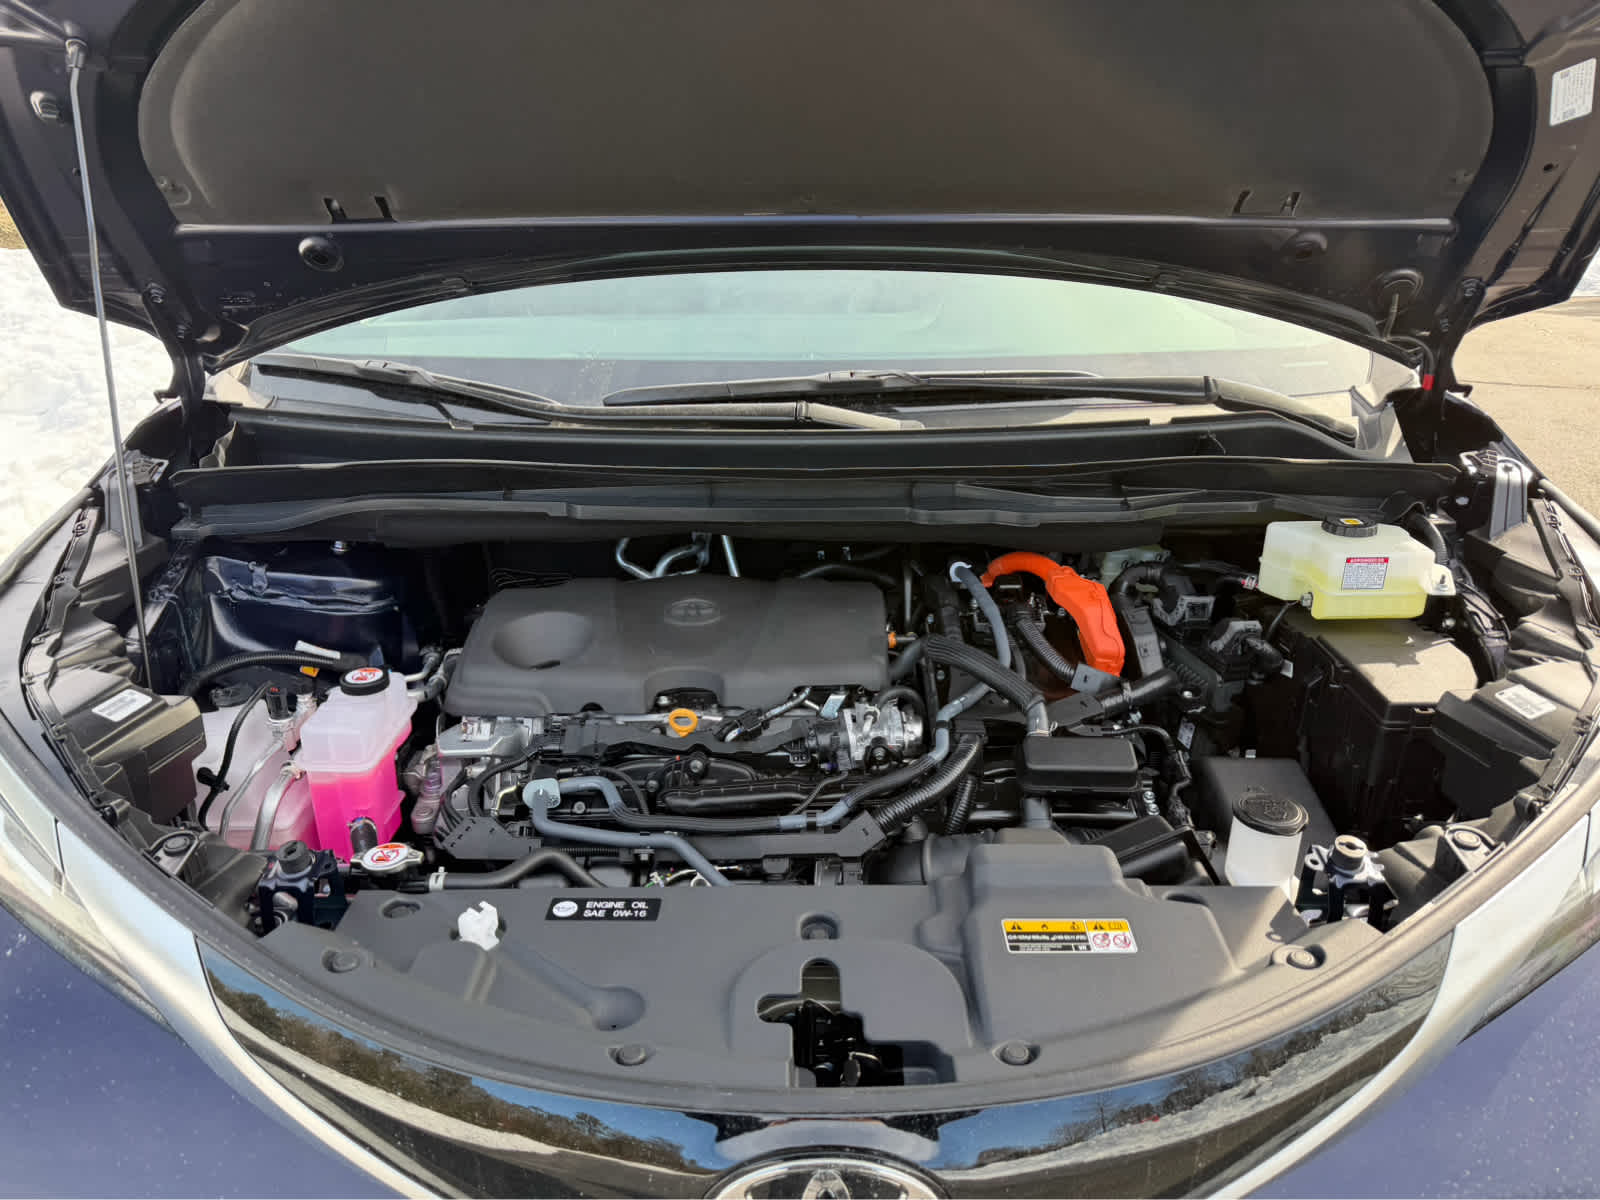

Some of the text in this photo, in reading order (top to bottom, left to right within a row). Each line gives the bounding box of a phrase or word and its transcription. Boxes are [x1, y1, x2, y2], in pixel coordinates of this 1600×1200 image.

[586, 901, 625, 909] ENGINE
[631, 901, 649, 909] OIL
[583, 909, 647, 917] SAE 0W-16
